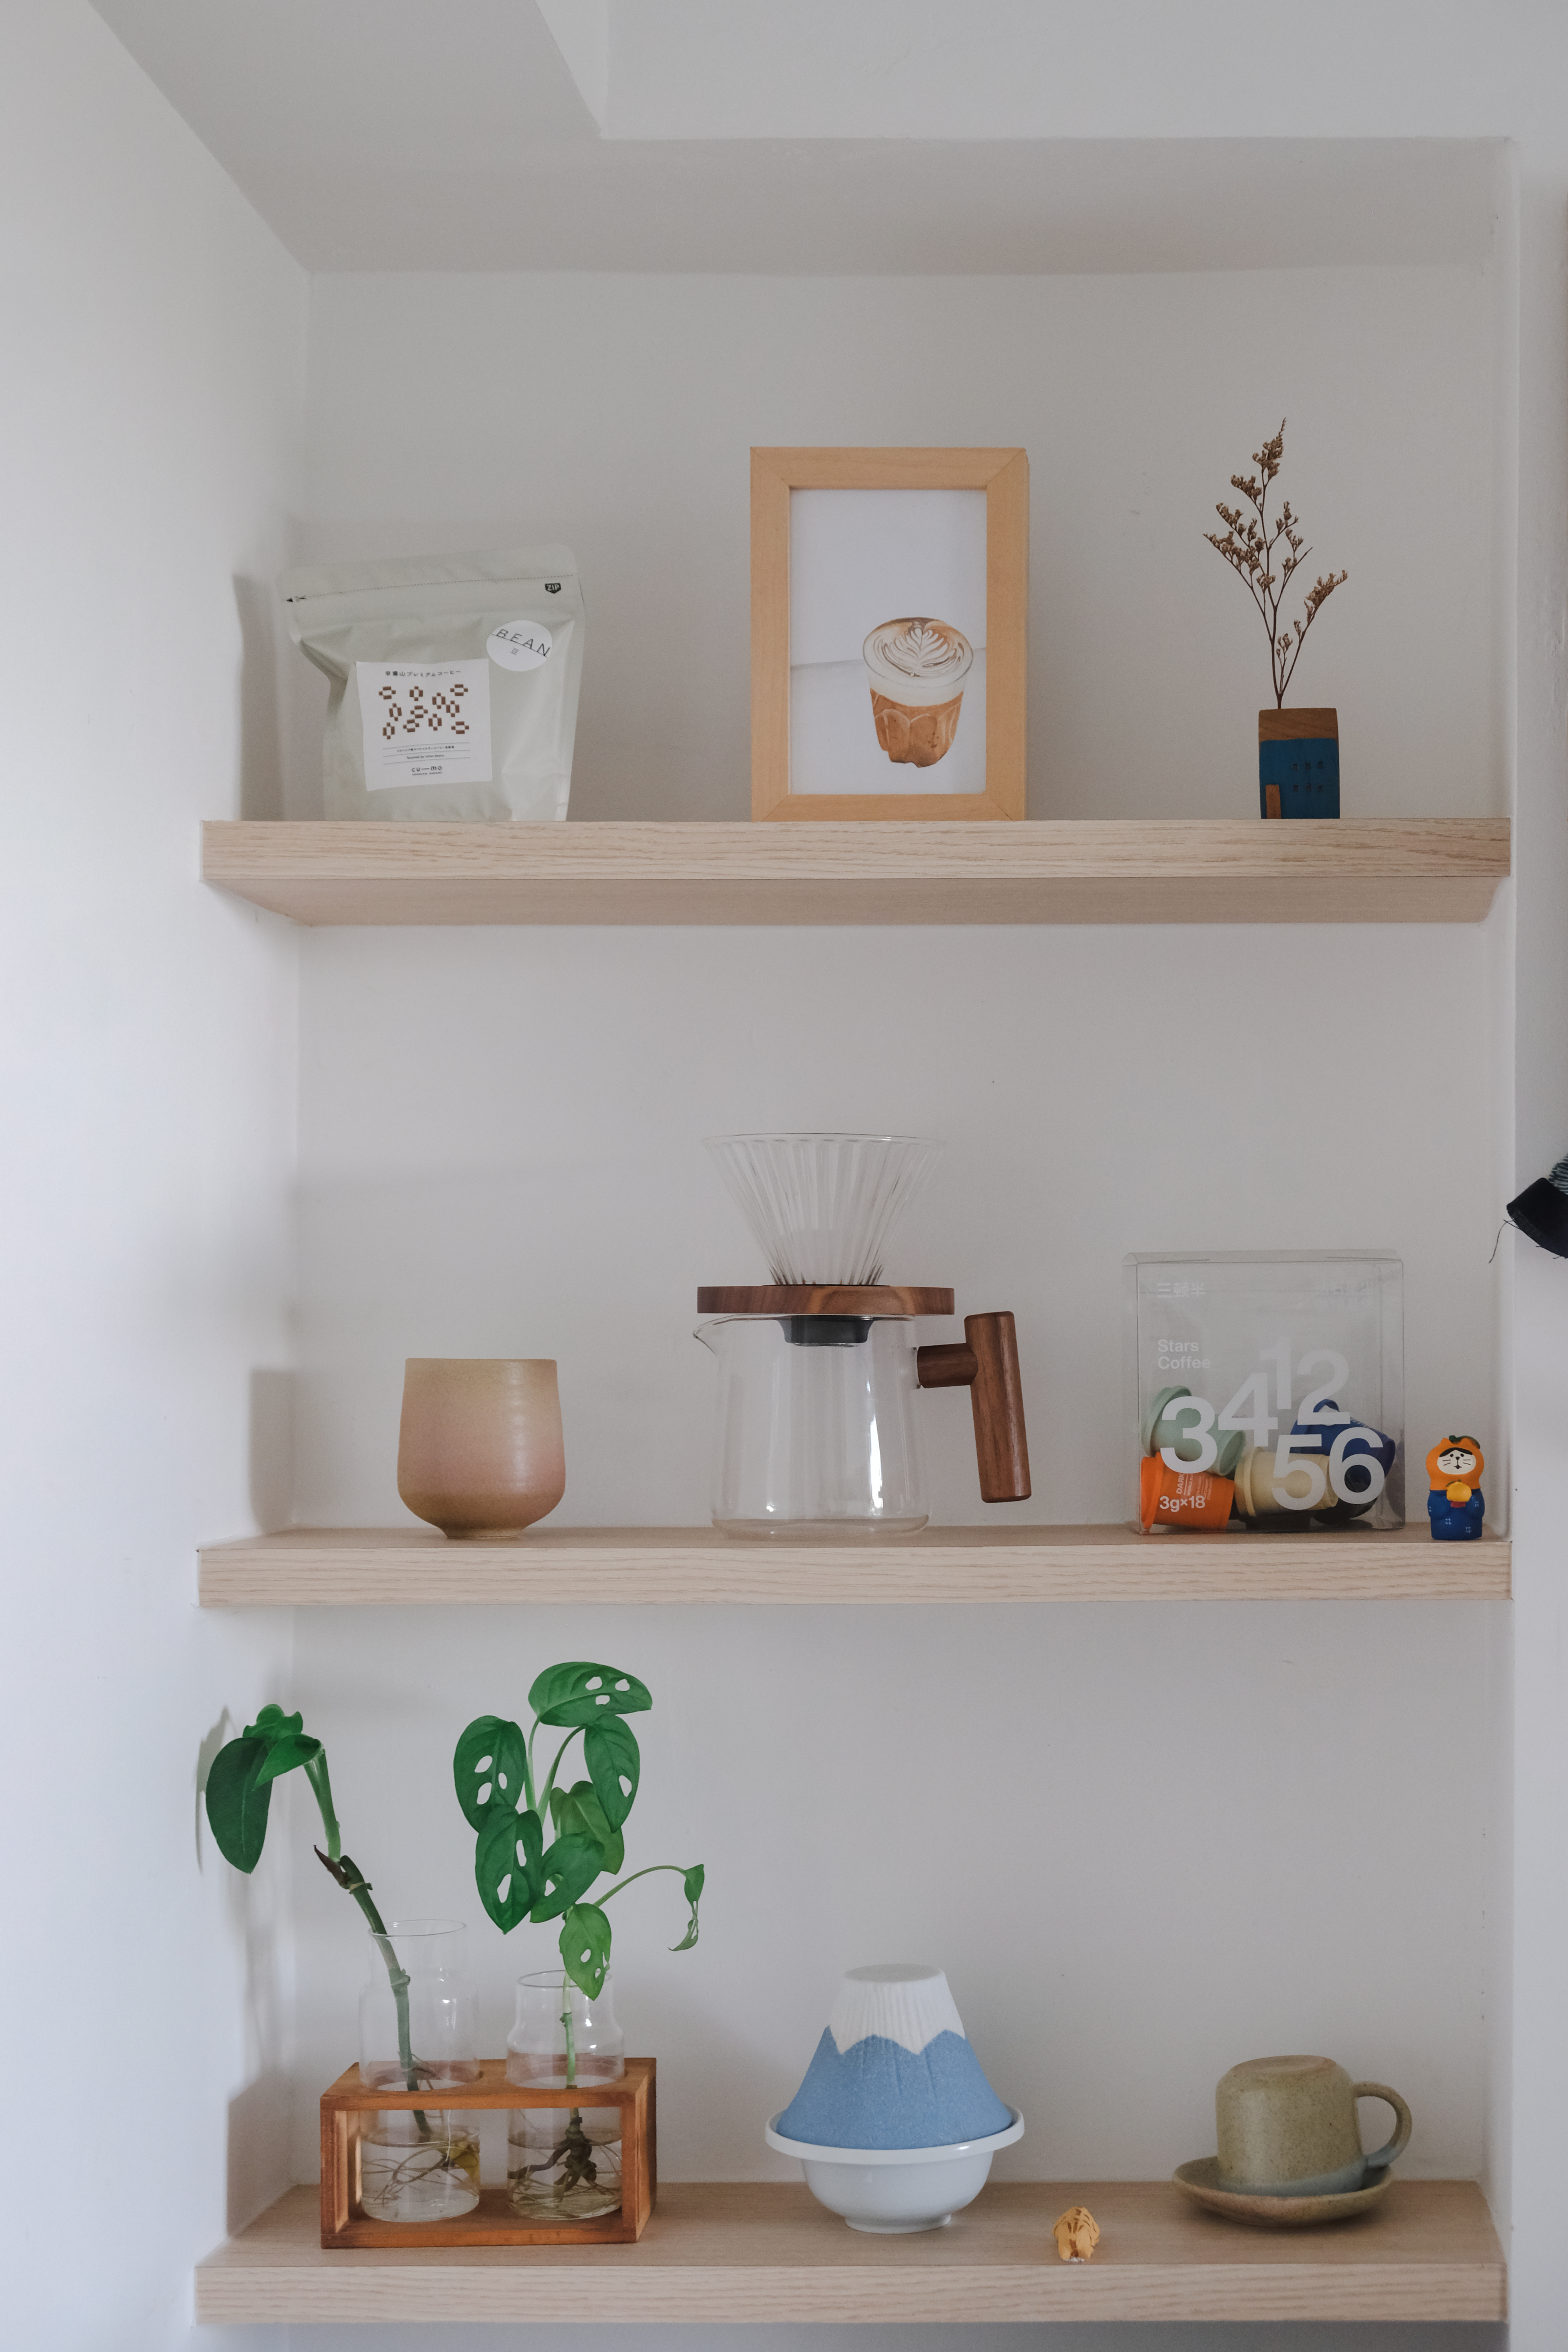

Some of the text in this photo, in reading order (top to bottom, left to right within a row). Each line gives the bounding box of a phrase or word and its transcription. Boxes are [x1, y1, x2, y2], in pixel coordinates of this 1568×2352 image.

[496, 628, 550, 657] BEAN
[1156, 1282, 1206, 1298] 三顿半
[1158, 1339, 1199, 1352] Stars
[1158, 1356, 1210, 1369] Coffee
[1176, 1472, 1185, 1494] DARK
